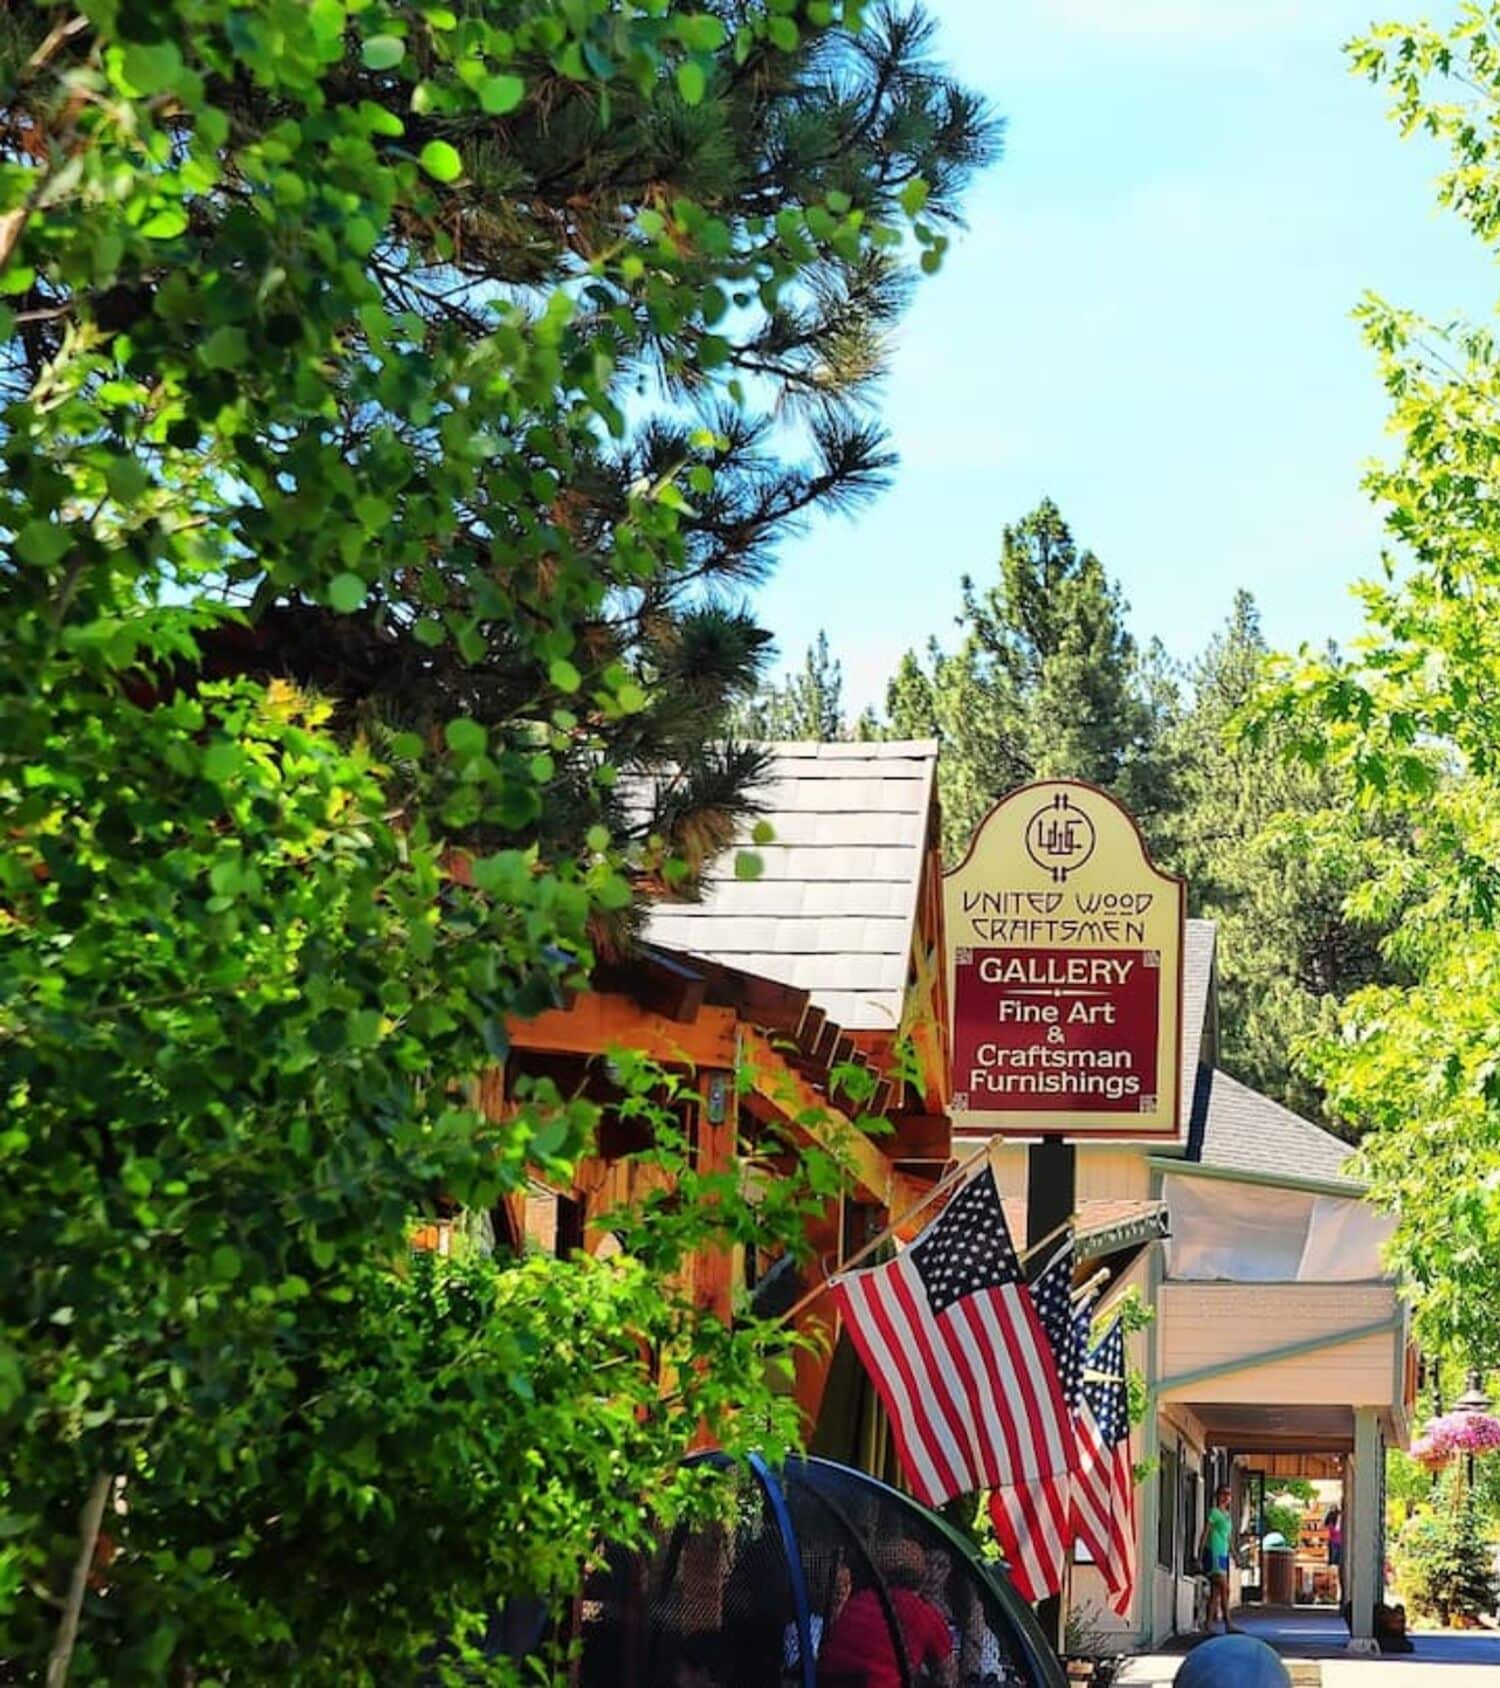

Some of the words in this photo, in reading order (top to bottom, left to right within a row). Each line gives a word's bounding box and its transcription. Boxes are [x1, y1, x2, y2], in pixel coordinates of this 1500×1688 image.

[1076, 892, 1154, 916] WOOD
[971, 919, 1146, 943] CRAFTSMEN
[979, 957, 1134, 985] GALLERY
[999, 1000, 1060, 1024] Fine
[1066, 1001, 1116, 1025] Art
[1047, 1025, 1066, 1044] &
[977, 1044, 1132, 1069] Craftsman
[969, 1069, 1141, 1099] Furnishings
